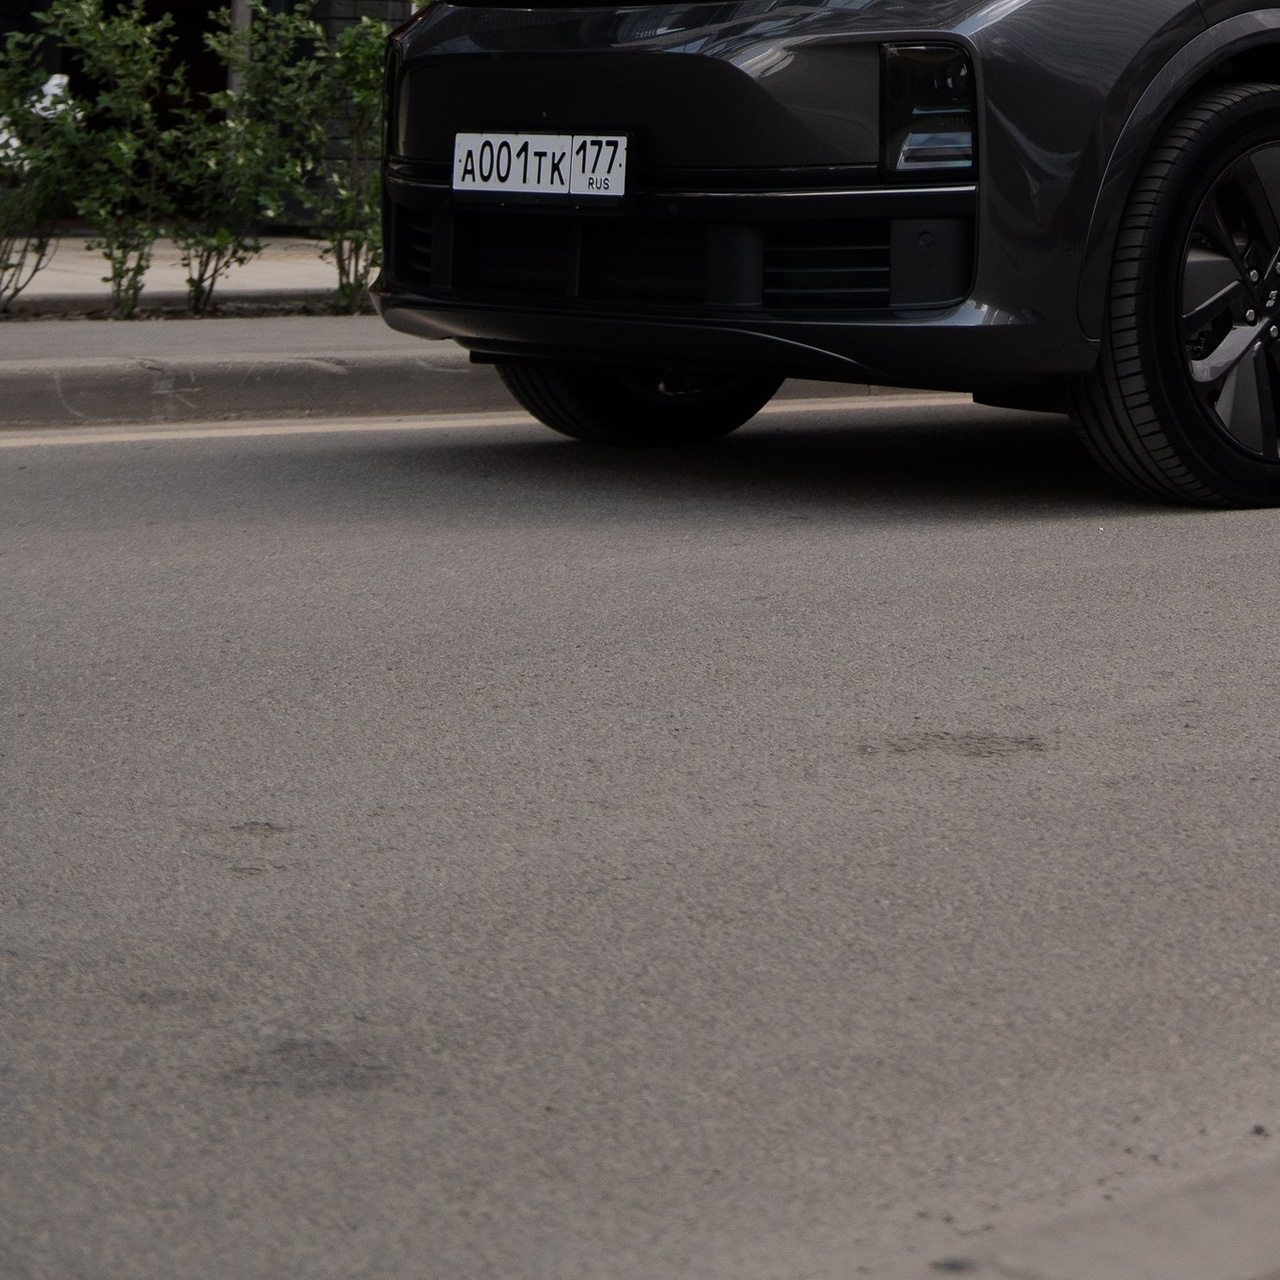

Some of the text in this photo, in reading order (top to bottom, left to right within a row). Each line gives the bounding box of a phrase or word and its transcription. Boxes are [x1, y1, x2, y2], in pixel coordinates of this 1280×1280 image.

[461, 139, 619, 186] А001ТК 177
[588, 177, 610, 190] RUS
